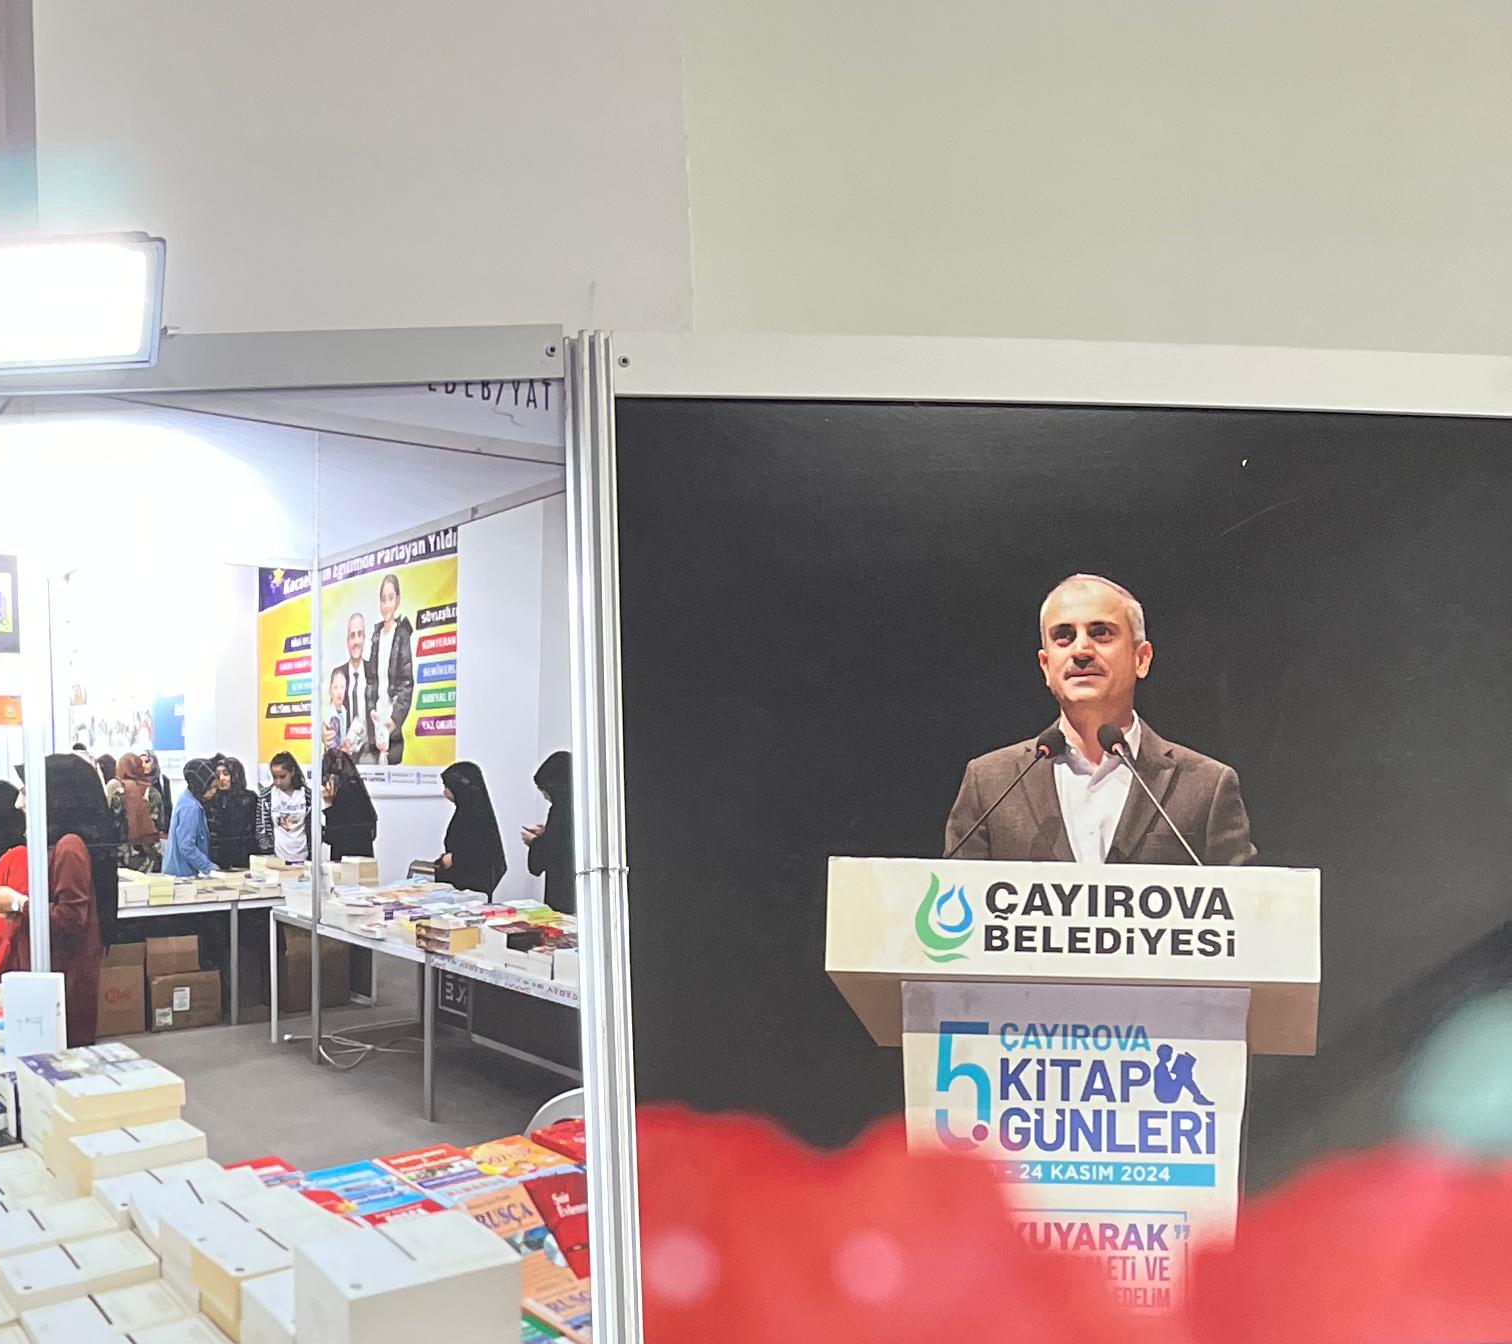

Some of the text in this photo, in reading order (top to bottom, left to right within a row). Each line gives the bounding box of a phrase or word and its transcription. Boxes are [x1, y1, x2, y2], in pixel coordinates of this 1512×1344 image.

[984, 880, 1233, 921] ÇAYIROVA
[999, 1023, 1151, 1051] ÇAYIROVA
[1000, 1058, 1152, 1103] KİTAP
[999, 1106, 1216, 1154] GÜNLERİ
[1019, 1163, 1172, 1182] 24 KASIM 2024
